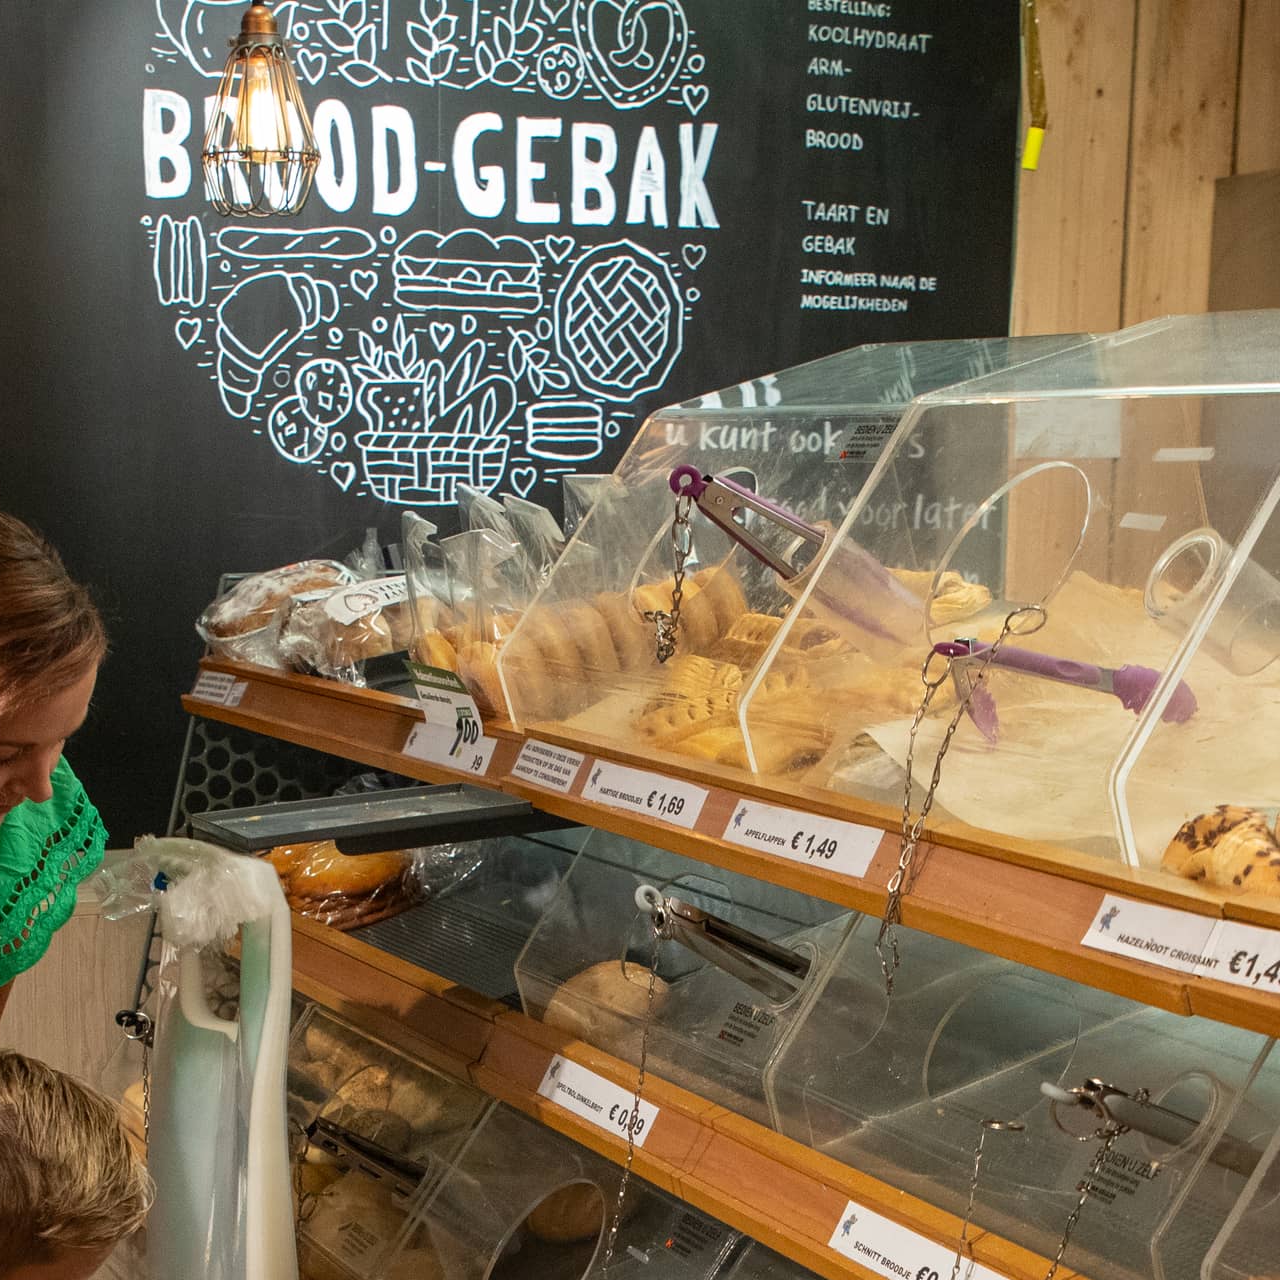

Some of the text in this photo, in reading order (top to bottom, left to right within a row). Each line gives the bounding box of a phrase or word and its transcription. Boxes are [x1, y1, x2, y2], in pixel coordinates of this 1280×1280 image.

[807, 0, 891, 17] BESTELLING:
[808, 24, 933, 54] KOOLHYDRAAT
[807, 57, 853, 76] ARM-
[806, 93, 921, 119] GLUTENVRIJ-
[805, 128, 864, 150] BROOD
[142, 88, 720, 229] BROOD-GEBAK
[801, 200, 889, 226] TAART EN
[801, 234, 856, 256] GEBAK
[800, 268, 937, 291] INFORMEER NAAR DE
[800, 294, 908, 313] MOGELIJKHEDEN
[665, 422, 688, 446] u
[700, 421, 777, 451] kunt
[790, 421, 843, 455] ook
[599, 787, 685, 816] HARTIGE BROODJES € 1,69
[744, 828, 838, 860] APPELFLAPPEN € 1,49
[1117, 934, 1170, 954] HAZELNOOT
[1169, 949, 1220, 969] CROISSANT
[609, 1103, 620, 1120] €
[853, 1240, 882, 1261] SCHNITT
[880, 1256, 912, 1280] BROODJE
